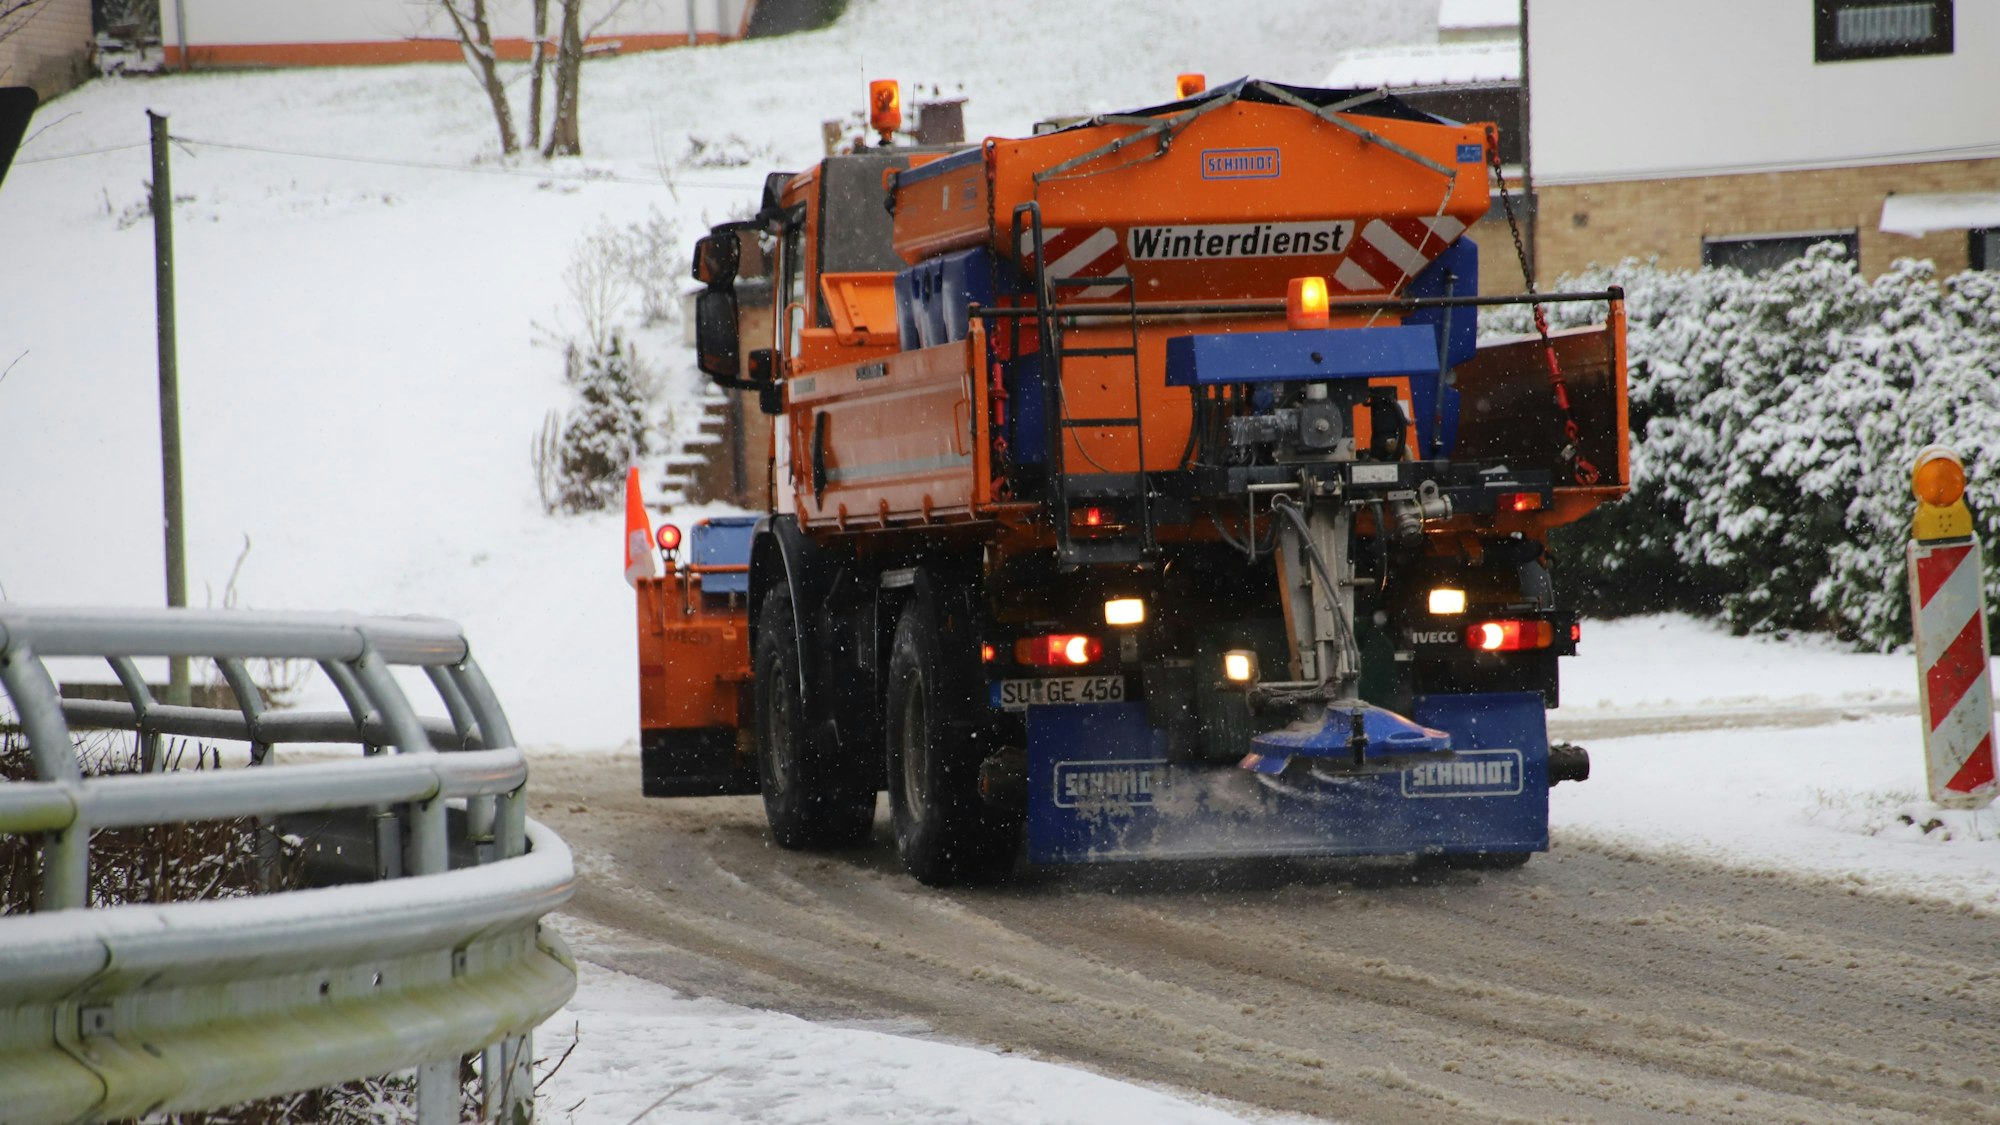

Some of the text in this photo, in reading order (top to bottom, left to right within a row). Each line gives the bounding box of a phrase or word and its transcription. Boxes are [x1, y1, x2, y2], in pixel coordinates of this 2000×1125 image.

[1209, 155, 1273, 172] SCHMIDT
[1133, 226, 1343, 258] Winterdienst
[1412, 630, 1458, 644] IVECO
[1003, 678, 1122, 704] SU GE 456
[1412, 761, 1514, 787] SCHMIDT
